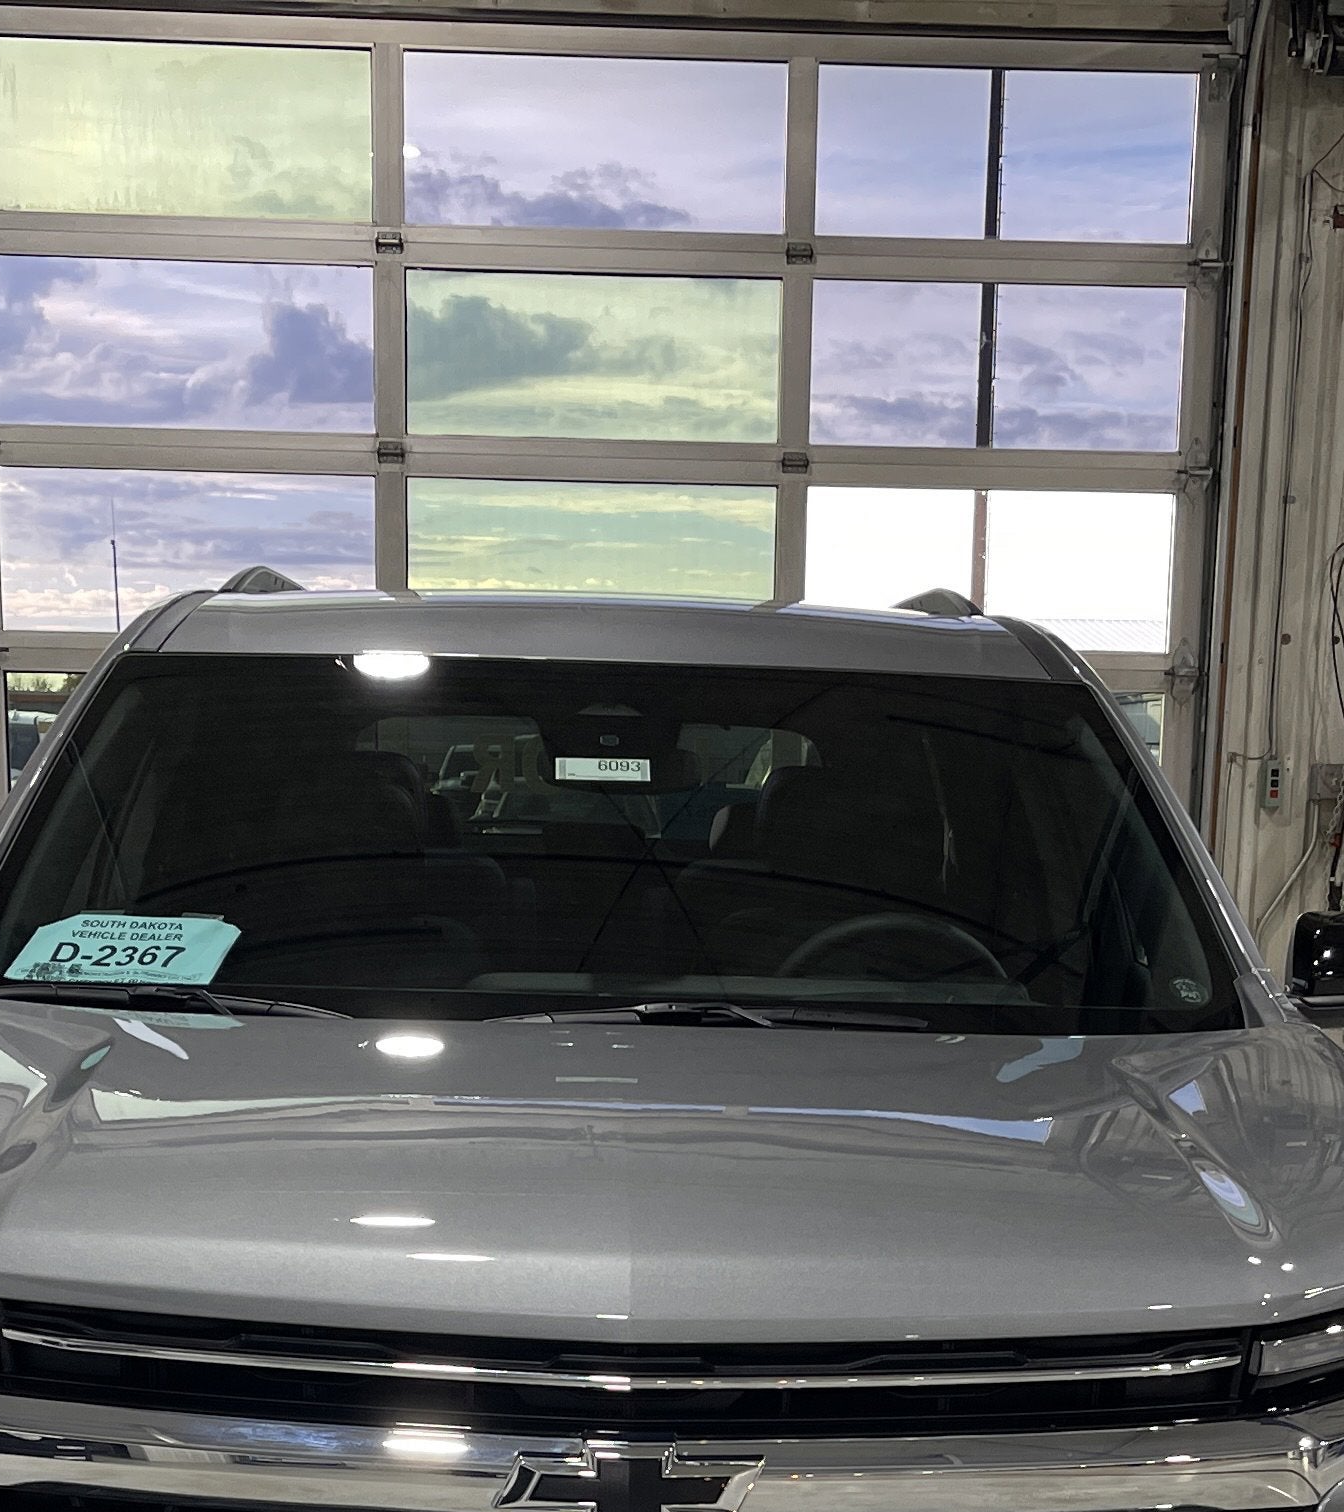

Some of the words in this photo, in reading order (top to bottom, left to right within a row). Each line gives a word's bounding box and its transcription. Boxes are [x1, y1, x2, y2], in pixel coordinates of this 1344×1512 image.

[81, 919, 126, 930] SOUTH
[130, 921, 183, 931] DAKOTA
[71, 930, 127, 941] VEHICLE
[130, 932, 183, 942] DEALER
[49, 942, 186, 968] D-2367
